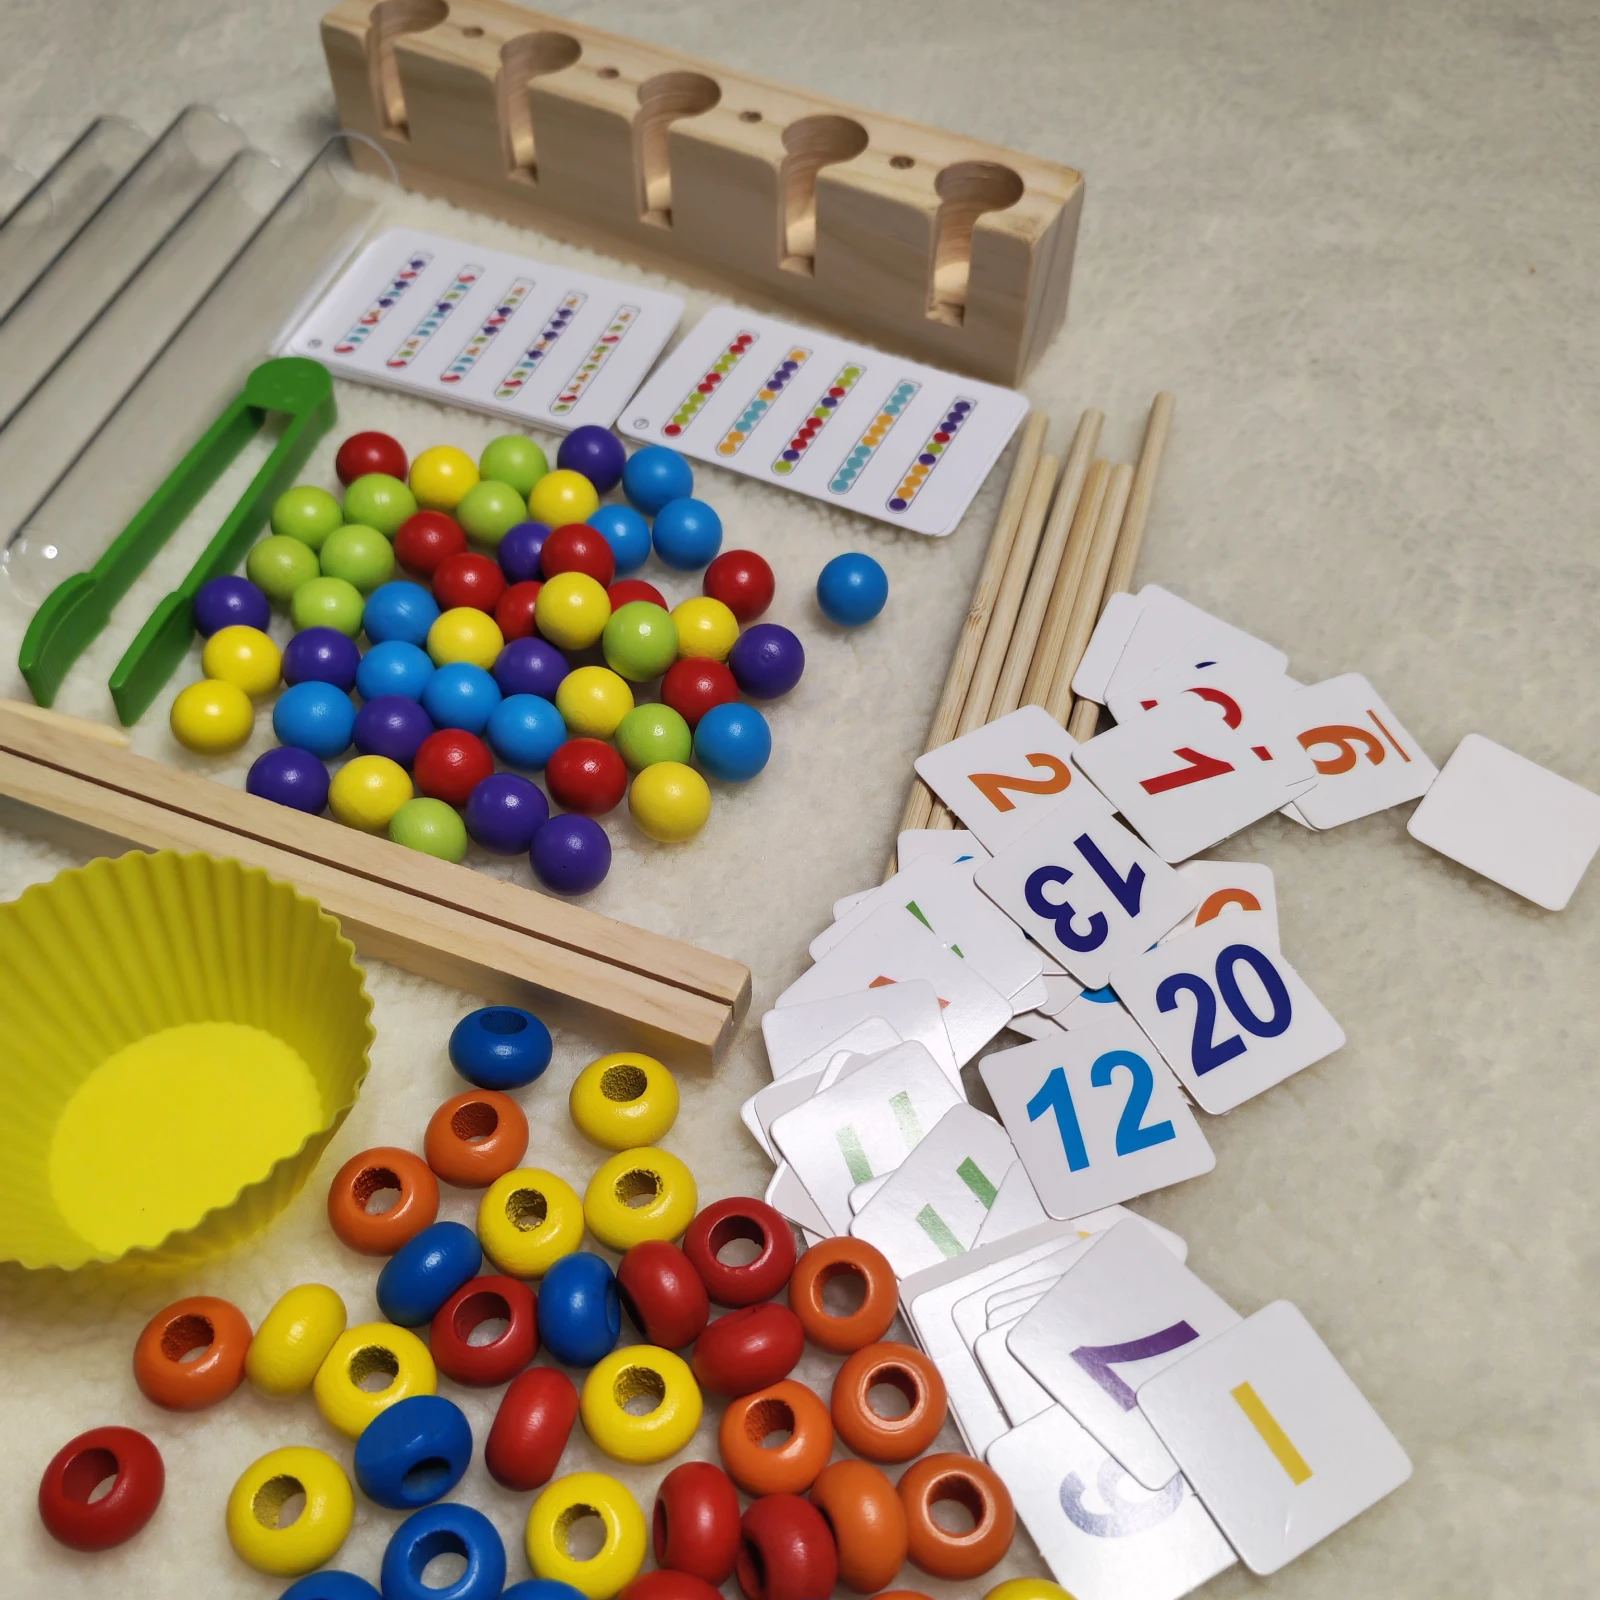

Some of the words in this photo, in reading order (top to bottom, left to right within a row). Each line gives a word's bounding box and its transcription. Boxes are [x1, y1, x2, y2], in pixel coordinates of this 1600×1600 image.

[968, 752, 1072, 813] 2
[1139, 747, 1235, 796] 1
[1024, 833, 1146, 953] 13
[1155, 944, 1292, 1077] 20
[1026, 1049, 1177, 1173] 12
